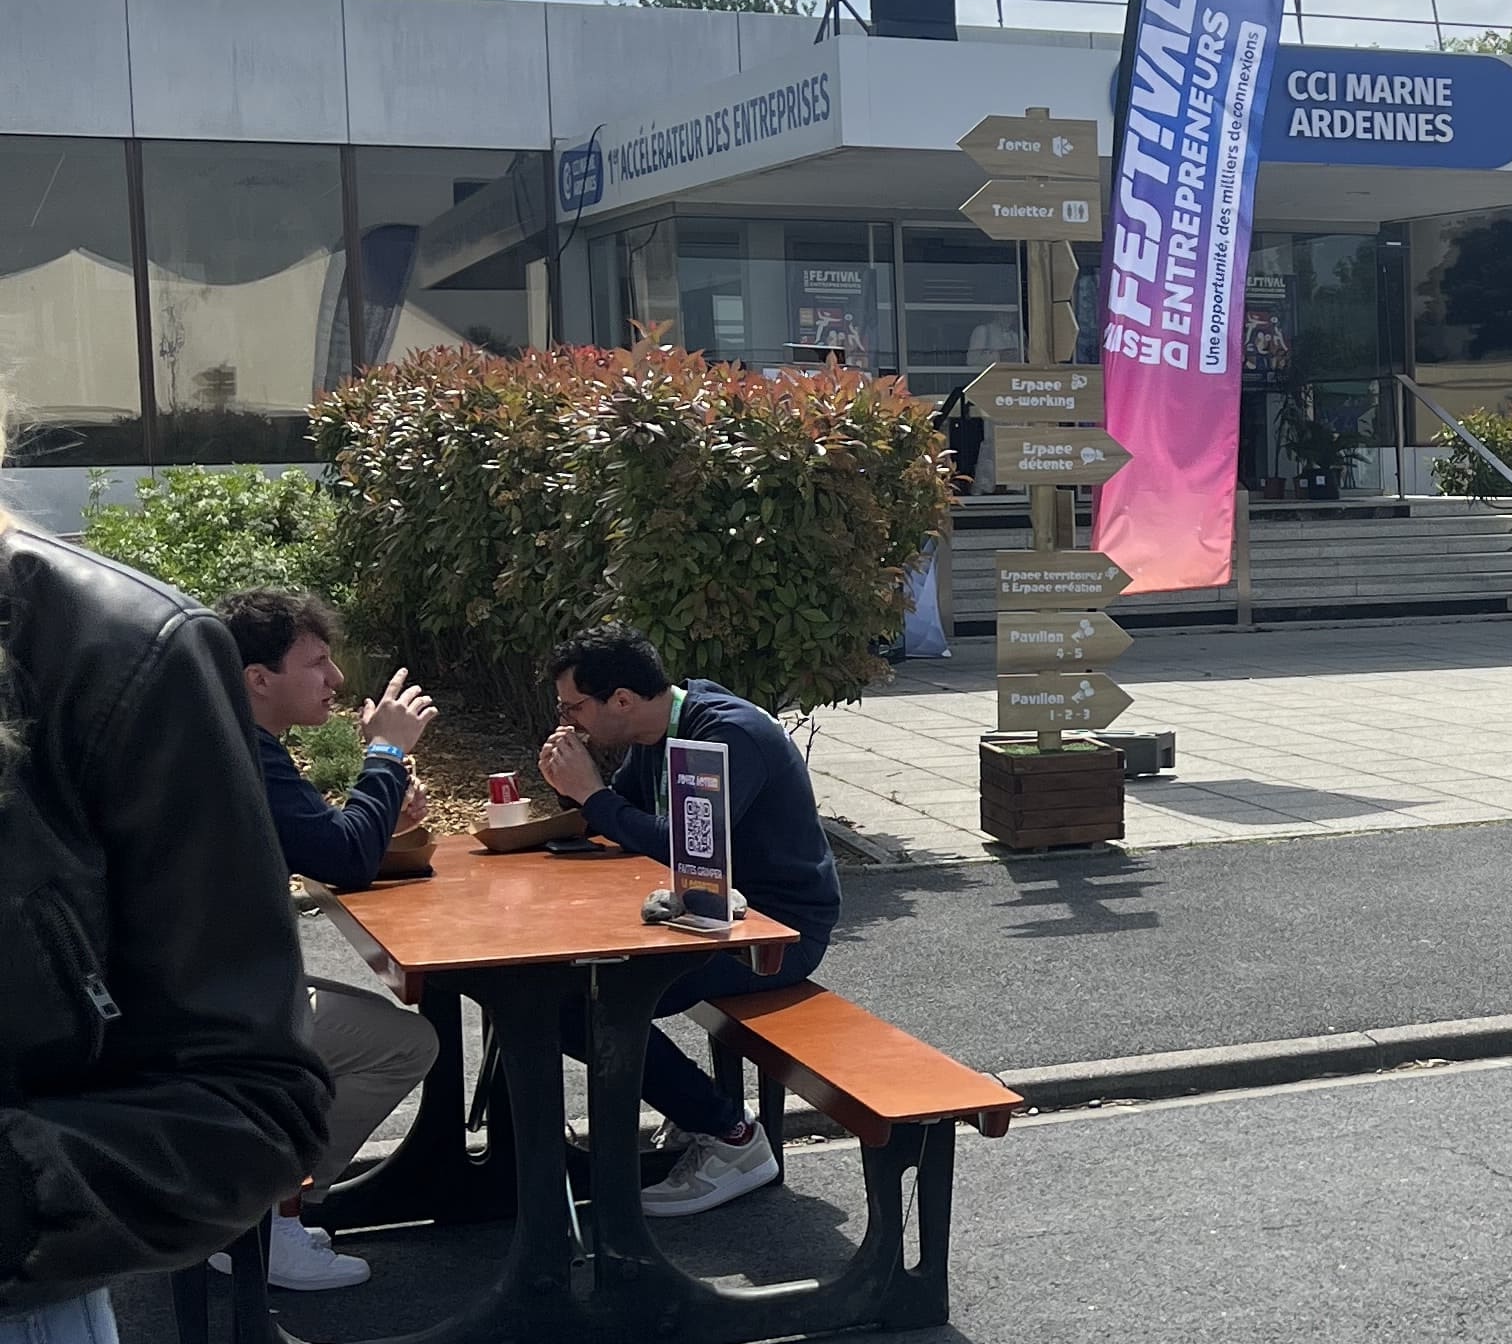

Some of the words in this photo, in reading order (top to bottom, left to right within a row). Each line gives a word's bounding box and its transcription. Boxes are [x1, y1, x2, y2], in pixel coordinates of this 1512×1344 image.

[1232, 31, 1259, 117] connexions
[1287, 70, 1337, 102] CCI
[1346, 73, 1453, 107] MARNE
[621, 119, 703, 182] ACCÉLÉRATEUR
[705, 111, 731, 155] DES
[734, 72, 831, 146] ENTREPRISES
[1228, 120, 1242, 141] de
[1289, 108, 1454, 143] ARDENNES
[997, 138, 1041, 153] Sortie
[1162, 8, 1229, 335] ENTREPRENEURS
[1220, 145, 1239, 205] milliers
[992, 203, 1055, 218] Toilettes
[1216, 208, 1232, 236] des
[1211, 240, 1229, 337] opportunité,
[1246, 276, 1286, 288] ESTIVAL
[1205, 338, 1221, 366] Une
[1011, 378, 1062, 393] Espace
[995, 394, 1075, 410] co-working
[1022, 442, 1072, 457] Espace
[1018, 457, 1073, 470] détente
[1001, 569, 1042, 583] Espace
[1043, 570, 1102, 581] territoires
[1011, 582, 1052, 594] Espace
[1054, 582, 1102, 593] création
[1010, 630, 1064, 644] Pavillon
[1011, 692, 1065, 705] Pavillon
